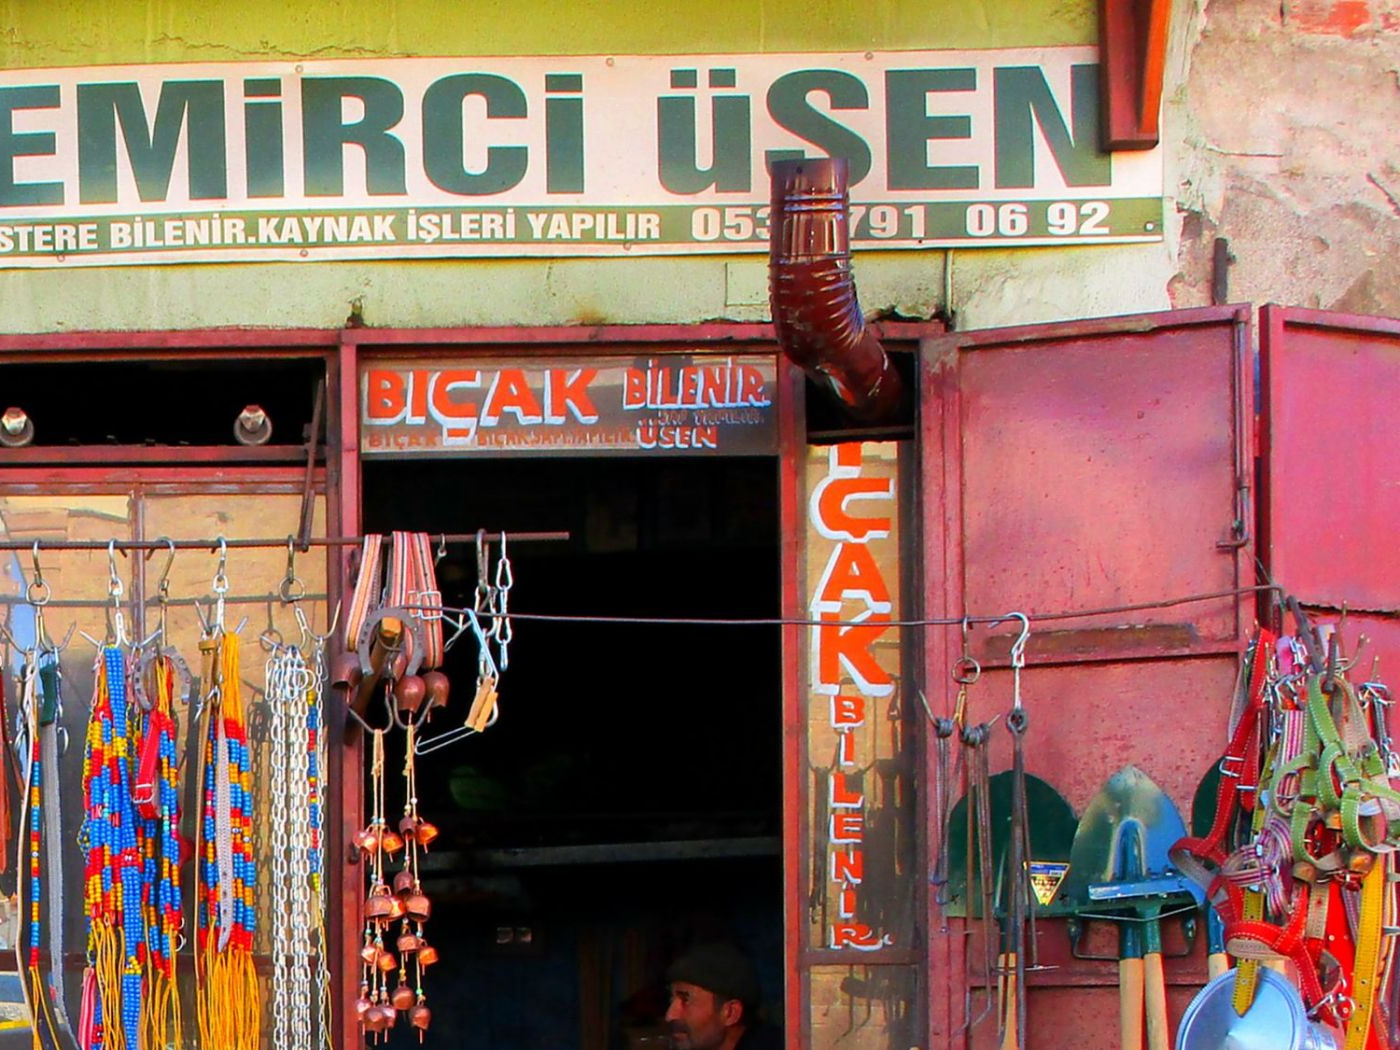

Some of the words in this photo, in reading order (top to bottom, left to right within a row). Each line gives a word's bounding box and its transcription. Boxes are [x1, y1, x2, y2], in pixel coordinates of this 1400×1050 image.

[407, 208, 515, 243] İŞLERİ
[527, 212, 661, 239] YAPILIR
[965, 203, 1028, 237] 06
[1046, 201, 1110, 235] 92
[363, 368, 600, 445] BIÇAK
[636, 418, 717, 449] ÜSEN
